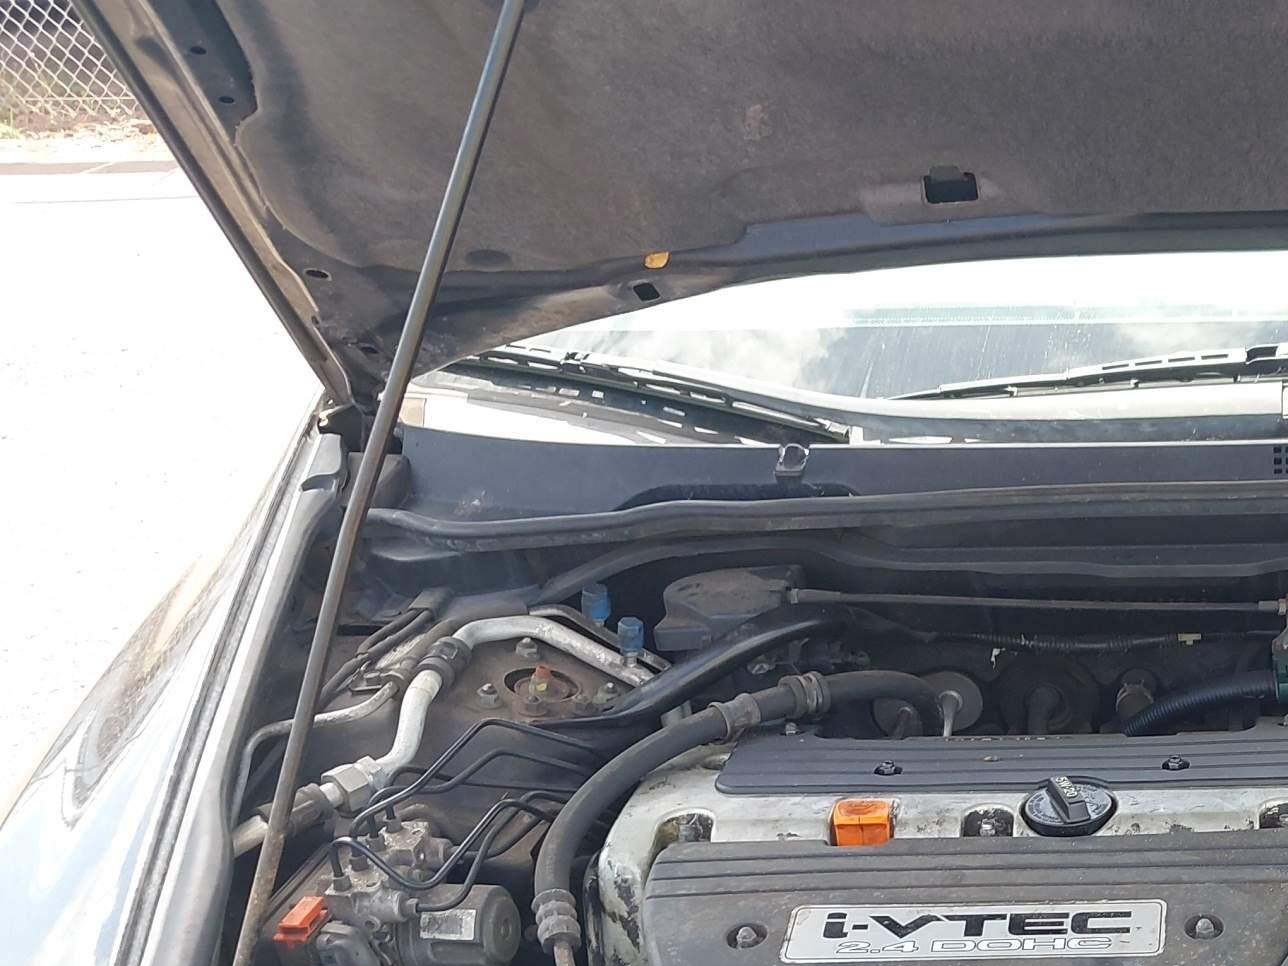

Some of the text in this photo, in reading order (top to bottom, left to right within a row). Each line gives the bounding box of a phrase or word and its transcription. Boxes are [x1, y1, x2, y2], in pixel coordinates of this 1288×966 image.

[822, 911, 1133, 939] i-VTEC
[836, 936, 1112, 954] 2.4 DOHC
